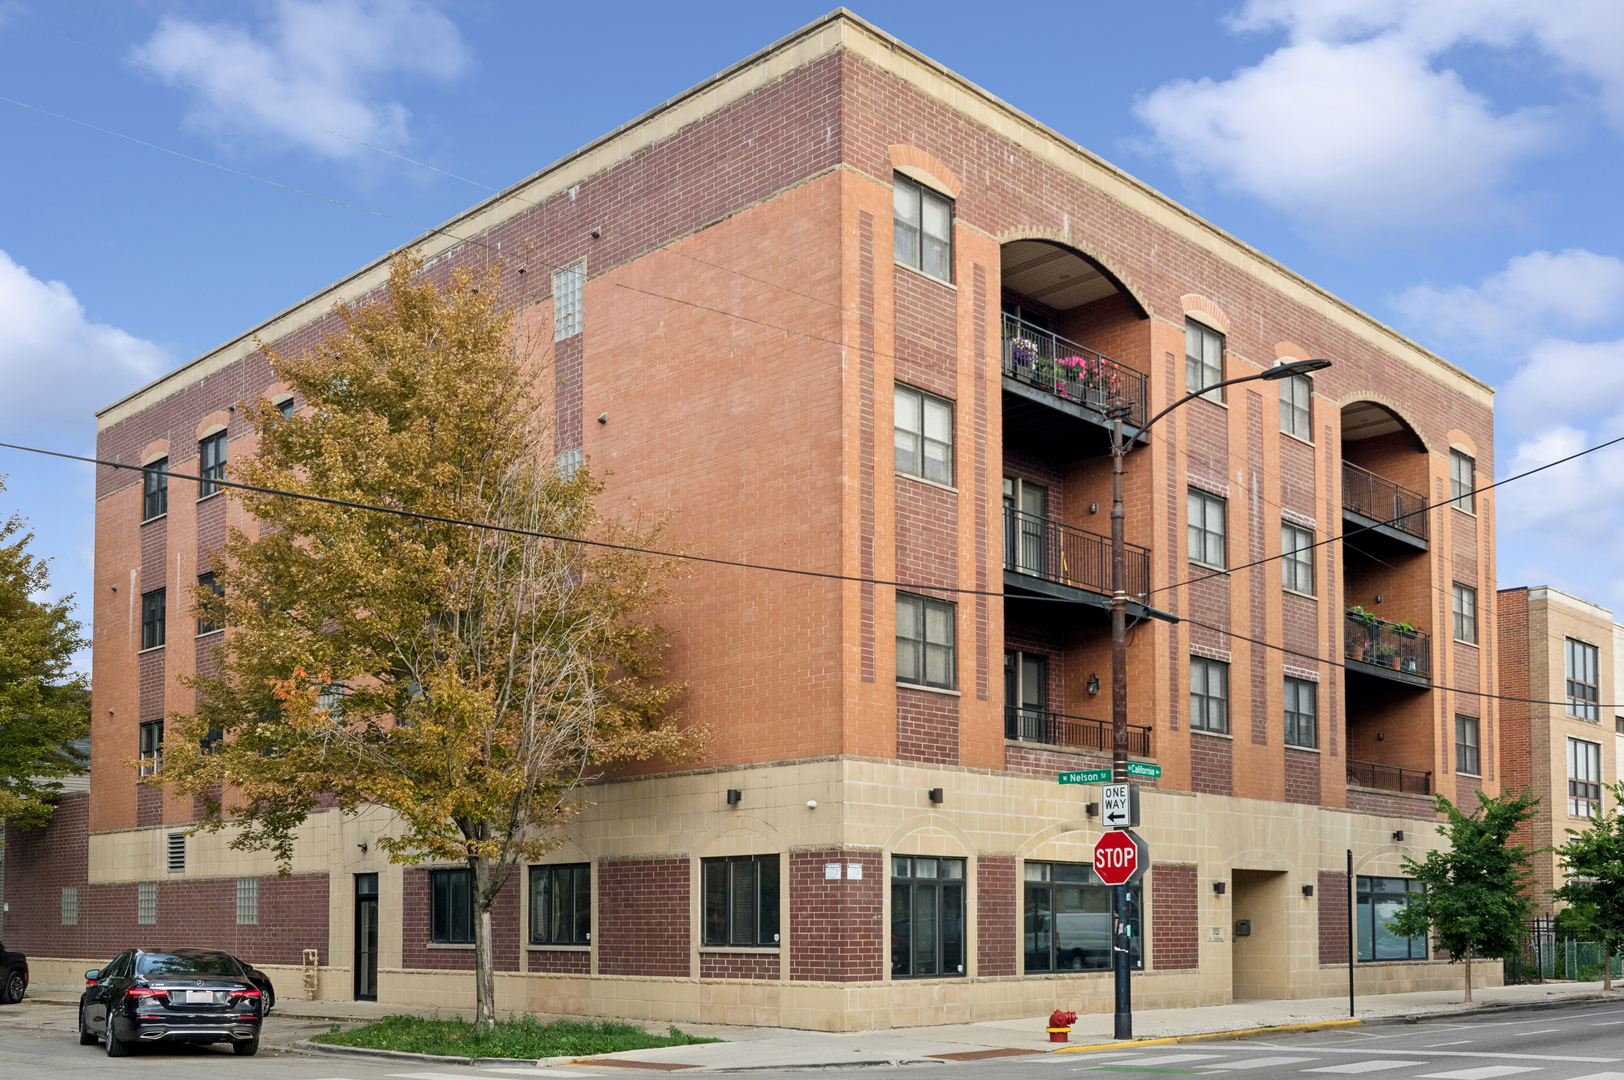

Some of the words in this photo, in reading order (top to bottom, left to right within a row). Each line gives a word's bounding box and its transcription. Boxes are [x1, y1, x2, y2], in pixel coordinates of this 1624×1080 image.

[1132, 764, 1155, 776] California
[1070, 773, 1098, 782] Nelson
[1105, 787, 1126, 798] ONE
[1105, 799, 1126, 809] WAY
[1096, 847, 1134, 868] STOP
